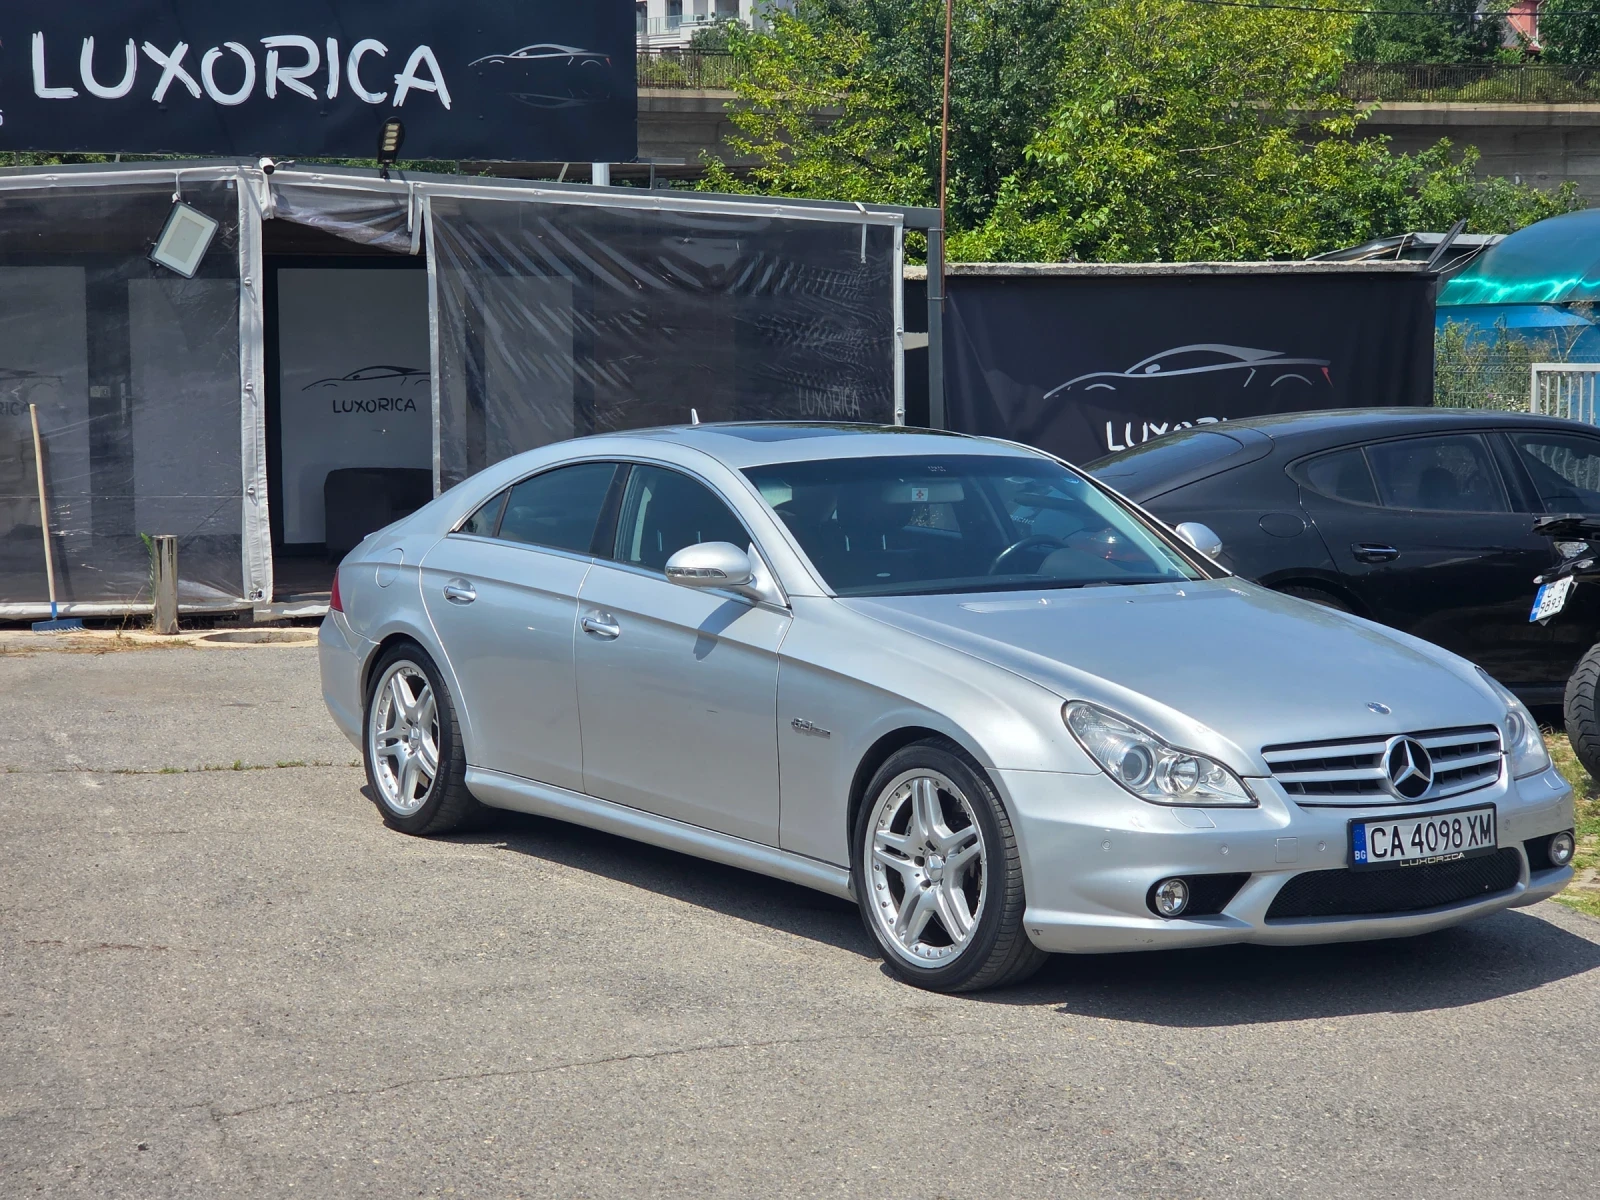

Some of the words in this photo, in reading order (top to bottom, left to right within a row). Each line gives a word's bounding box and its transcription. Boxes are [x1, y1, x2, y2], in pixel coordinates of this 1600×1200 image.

[32, 30, 451, 110] LUXORICA
[333, 398, 416, 413] LUXORICA
[1540, 596, 1562, 614] 9893
[1370, 825, 1406, 859] CA
[1410, 818, 1463, 854] 4098
[1466, 813, 1492, 847] XM
[1354, 850, 1366, 861] BG
[1400, 852, 1466, 867] LUXORICA
